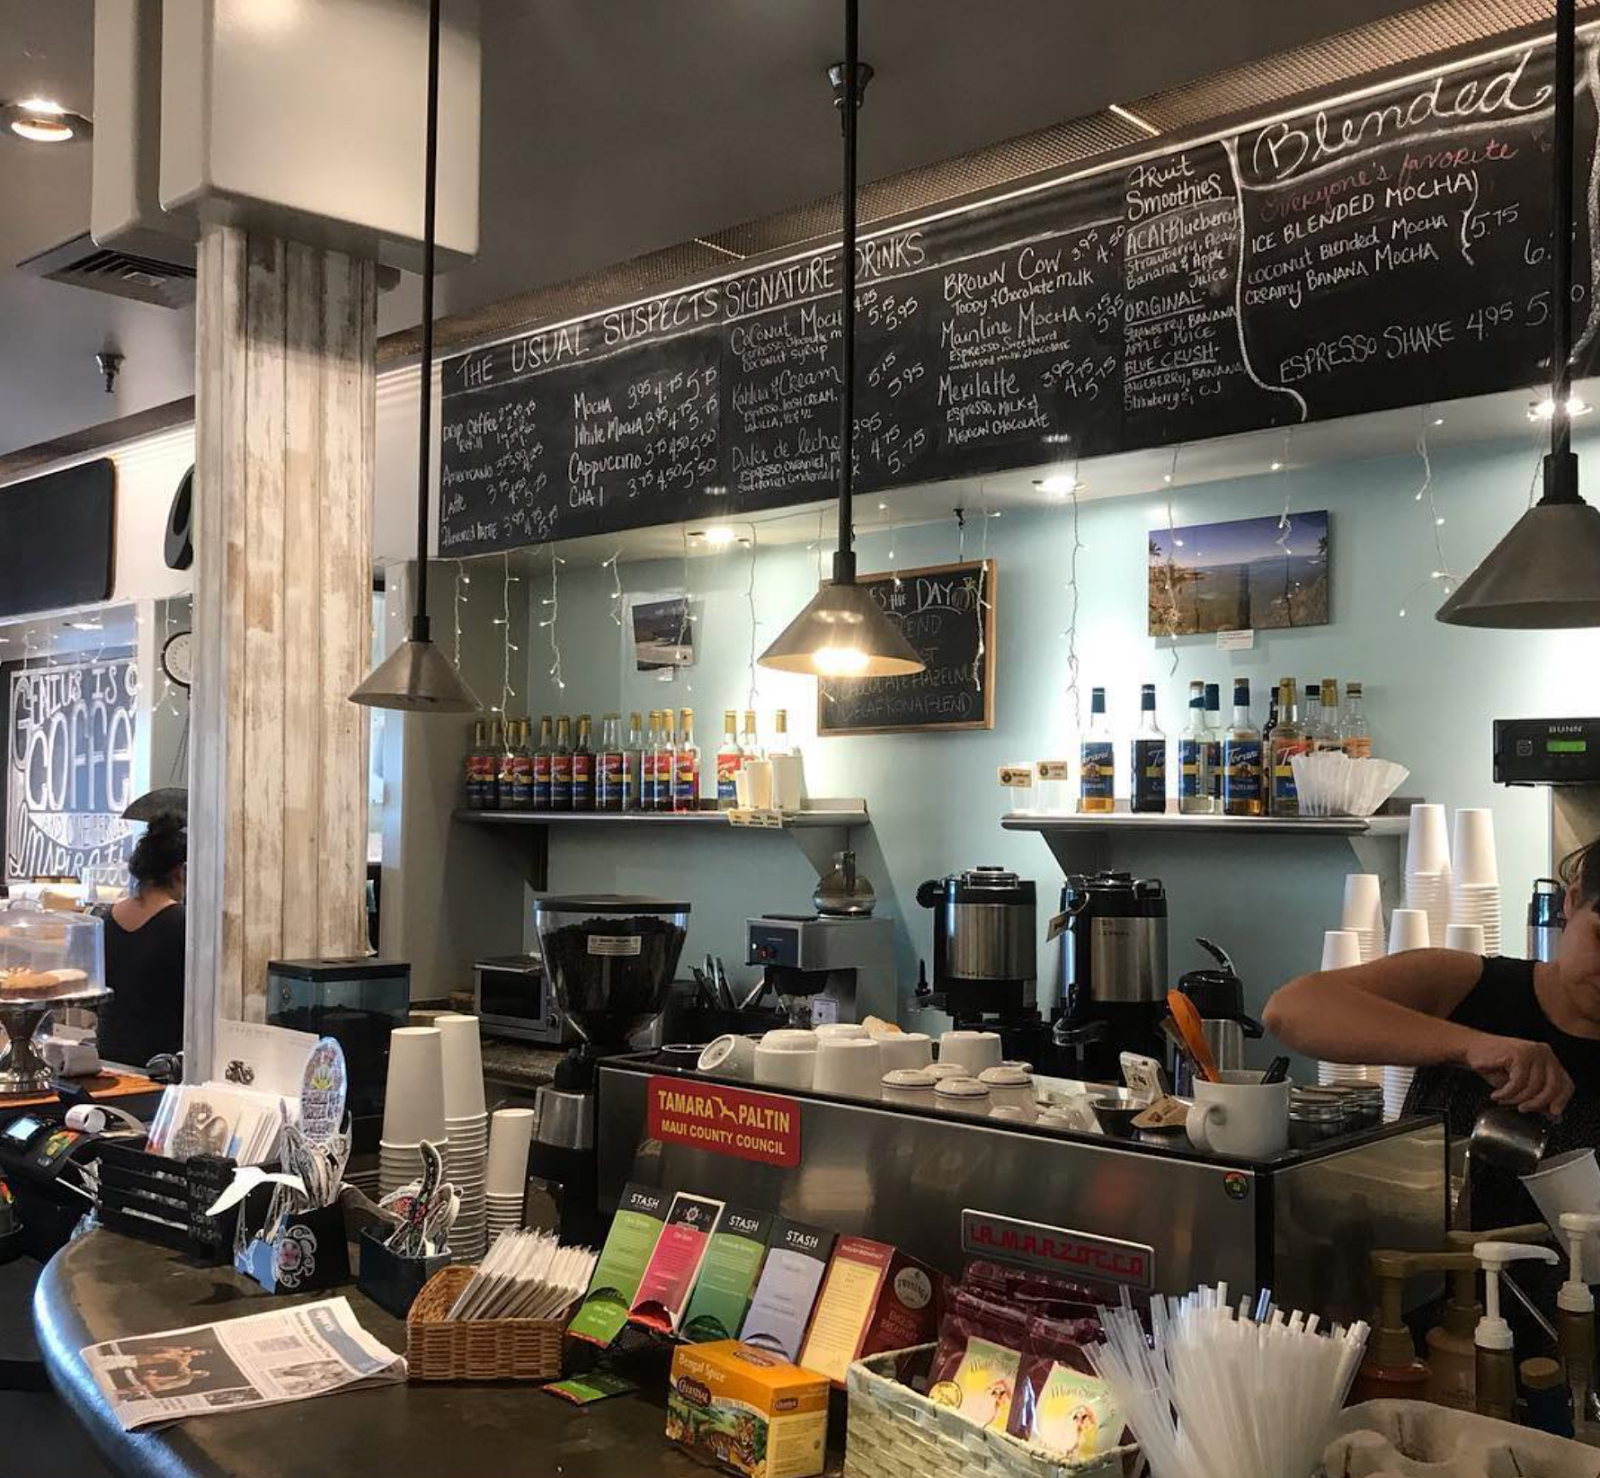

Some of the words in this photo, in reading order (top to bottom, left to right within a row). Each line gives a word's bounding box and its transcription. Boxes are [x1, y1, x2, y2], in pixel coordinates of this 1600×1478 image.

[1253, 49, 1552, 180] Blended
[1129, 155, 1195, 189] Fruit
[1399, 139, 1518, 187] favorite
[1126, 174, 1223, 221] Smoothies
[1251, 237, 1276, 254] ICE
[1283, 193, 1376, 244] BLENDED
[1385, 172, 1474, 210] MOCHA
[944, 262, 1007, 302] BROWN
[1126, 262, 1177, 291] Banana
[1193, 248, 1224, 273] Apple
[1188, 266, 1228, 289] Juice
[456, 354, 494, 388] THE
[510, 326, 590, 373] USUAL
[602, 289, 719, 346] SUSPECTS
[801, 303, 842, 339] MOCH
[941, 317, 1012, 350] Mainline
[1171, 326, 1217, 347] JUICE
[1280, 336, 1377, 384] ESPRESSO
[1383, 322, 1456, 360] SHAKE
[1466, 304, 1514, 342] 4.95
[1124, 353, 1155, 377] BLUE
[773, 439, 790, 459] de
[798, 427, 841, 456] leche
[917, 579, 953, 610] DAY
[92, 665, 117, 705] IS
[1549, 725, 1583, 733] BUNN
[658, 1090, 714, 1119] TAMARA
[738, 1104, 789, 1133] PALTIN
[662, 1119, 687, 1135] MAUI
[690, 1125, 733, 1144] COUNTY
[736, 1134, 786, 1155] COUNCIL
[630, 1193, 660, 1209] STASH
[728, 1215, 760, 1232] STASH
[785, 1230, 819, 1249] STASH
